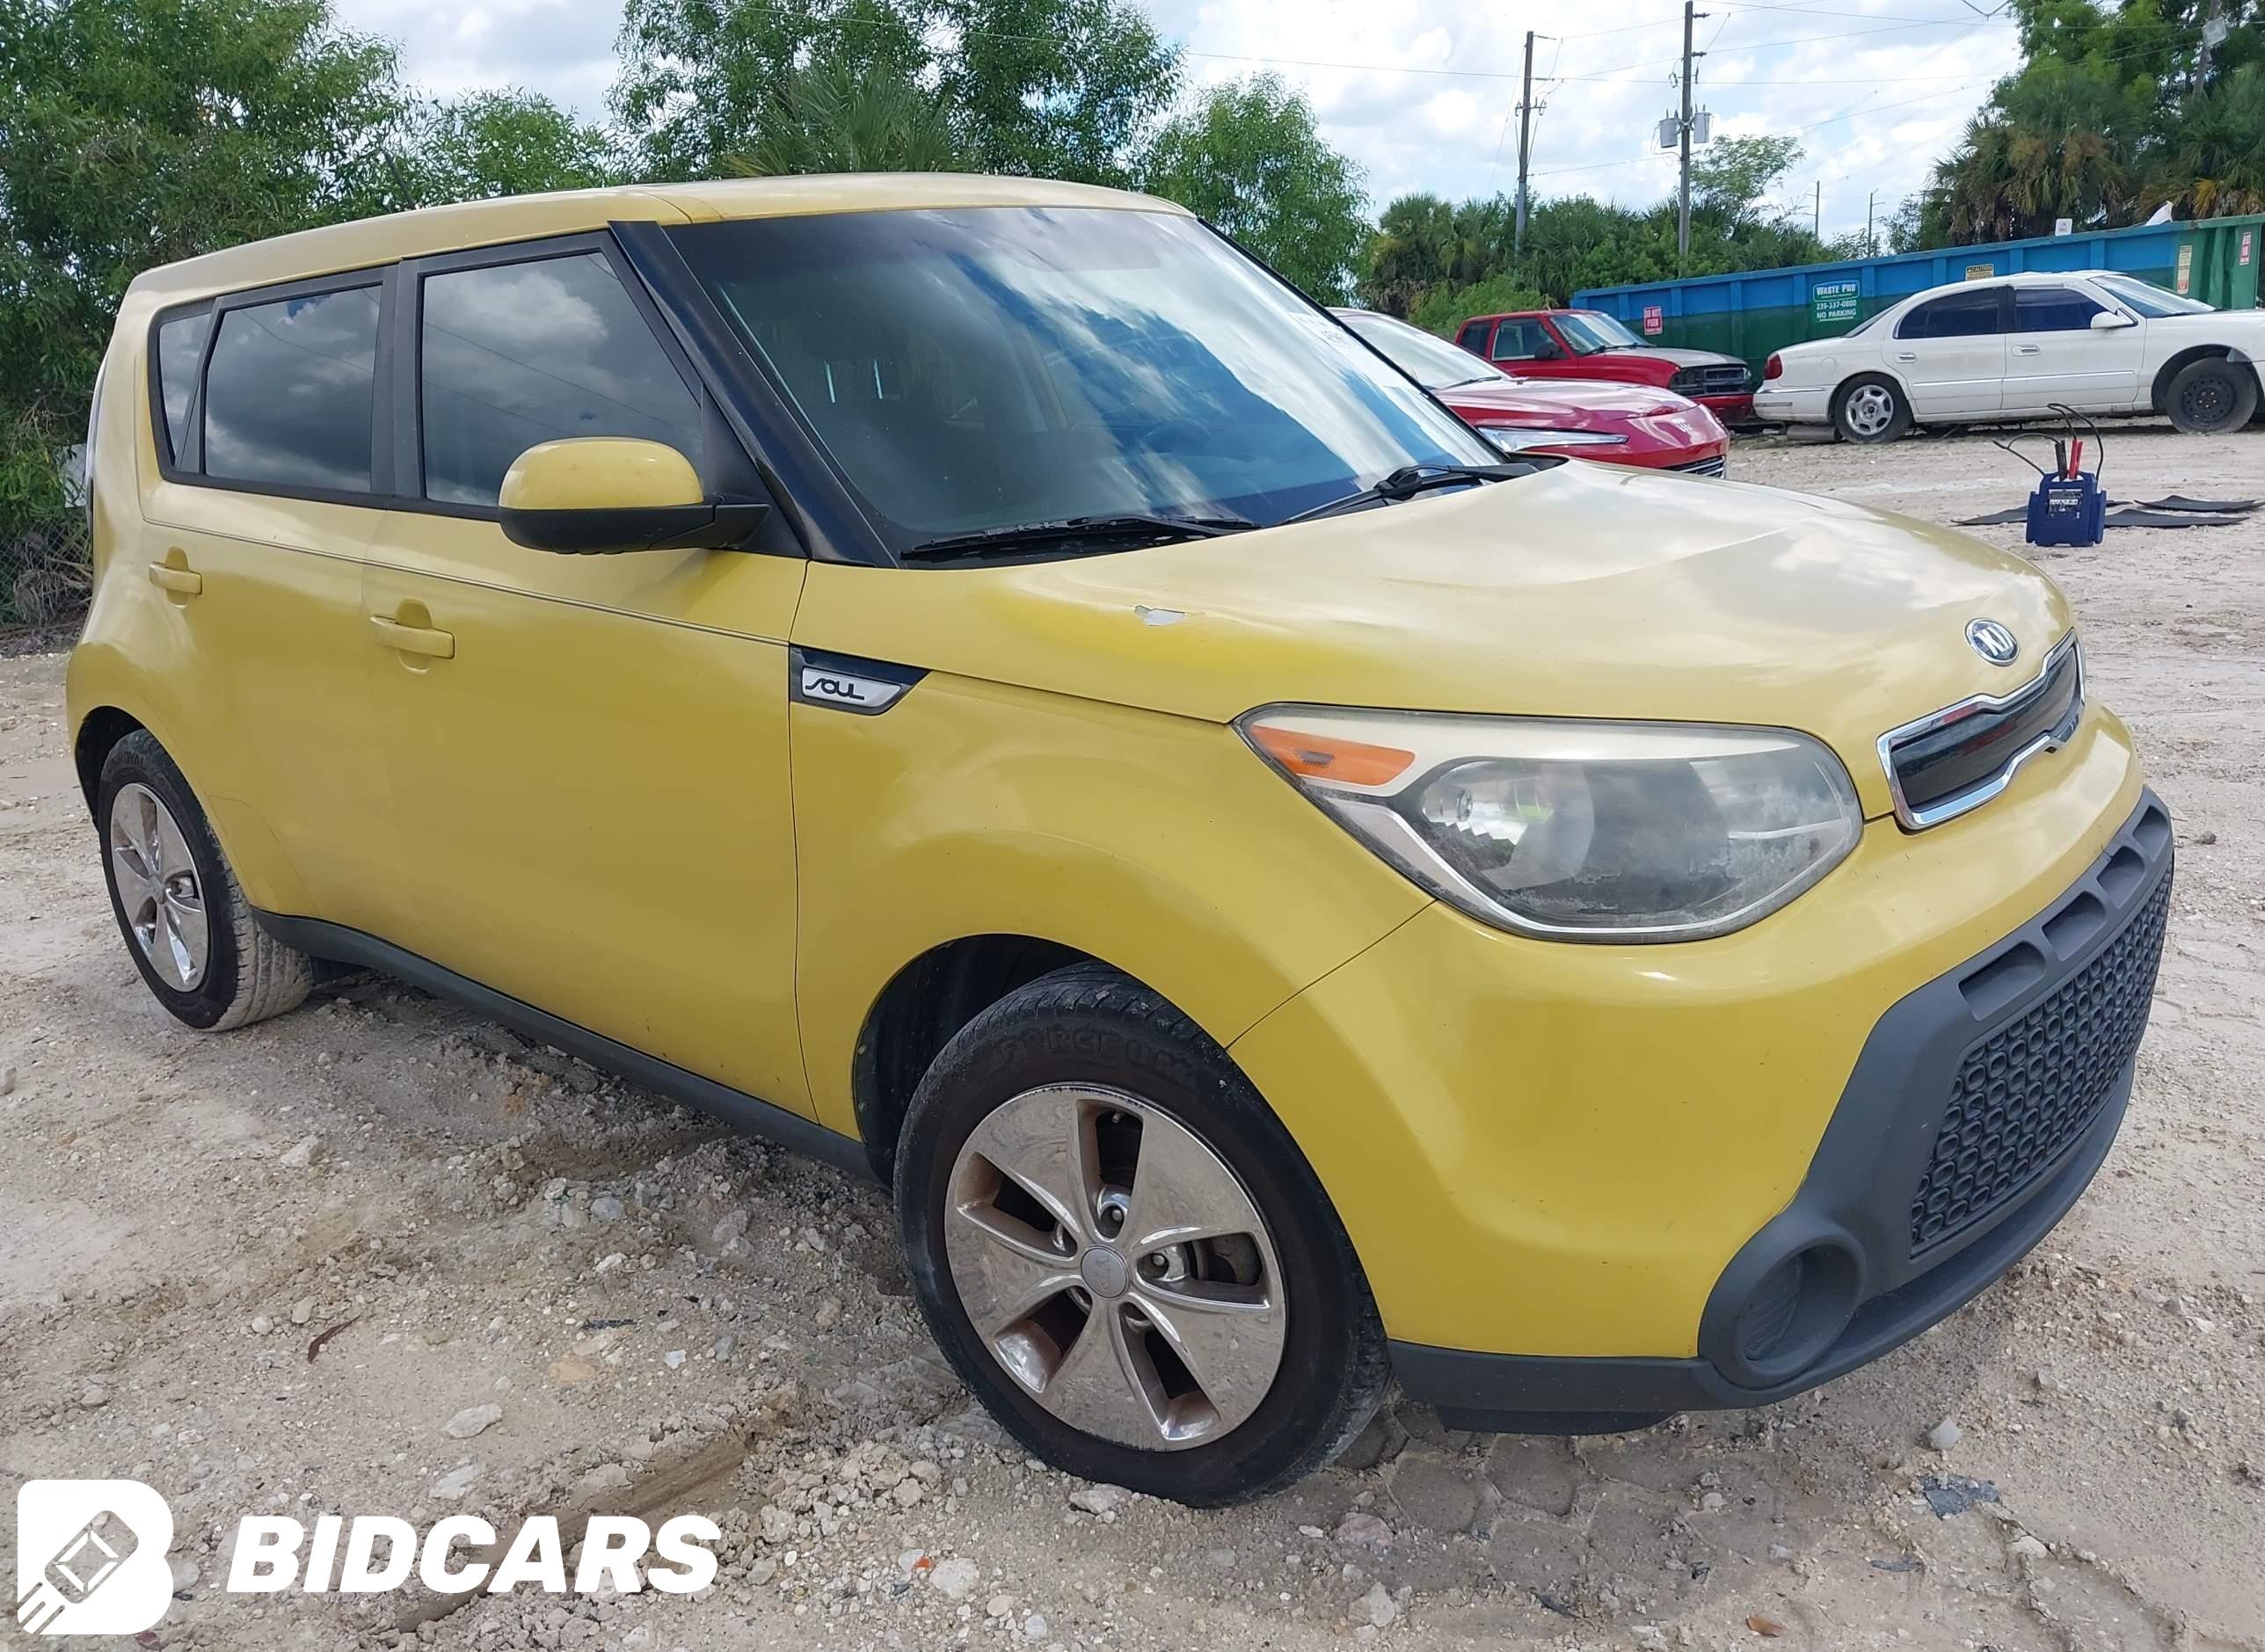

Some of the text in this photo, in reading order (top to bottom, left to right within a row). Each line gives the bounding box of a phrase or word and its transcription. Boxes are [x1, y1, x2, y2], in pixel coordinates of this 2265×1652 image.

[1816, 285, 1839, 295] WASTE
[1841, 283, 1856, 293] PRO
[1816, 299, 1857, 310] 239-337-0800
[1828, 309, 1857, 318] PARKING
[805, 677, 865, 701] SOUL
